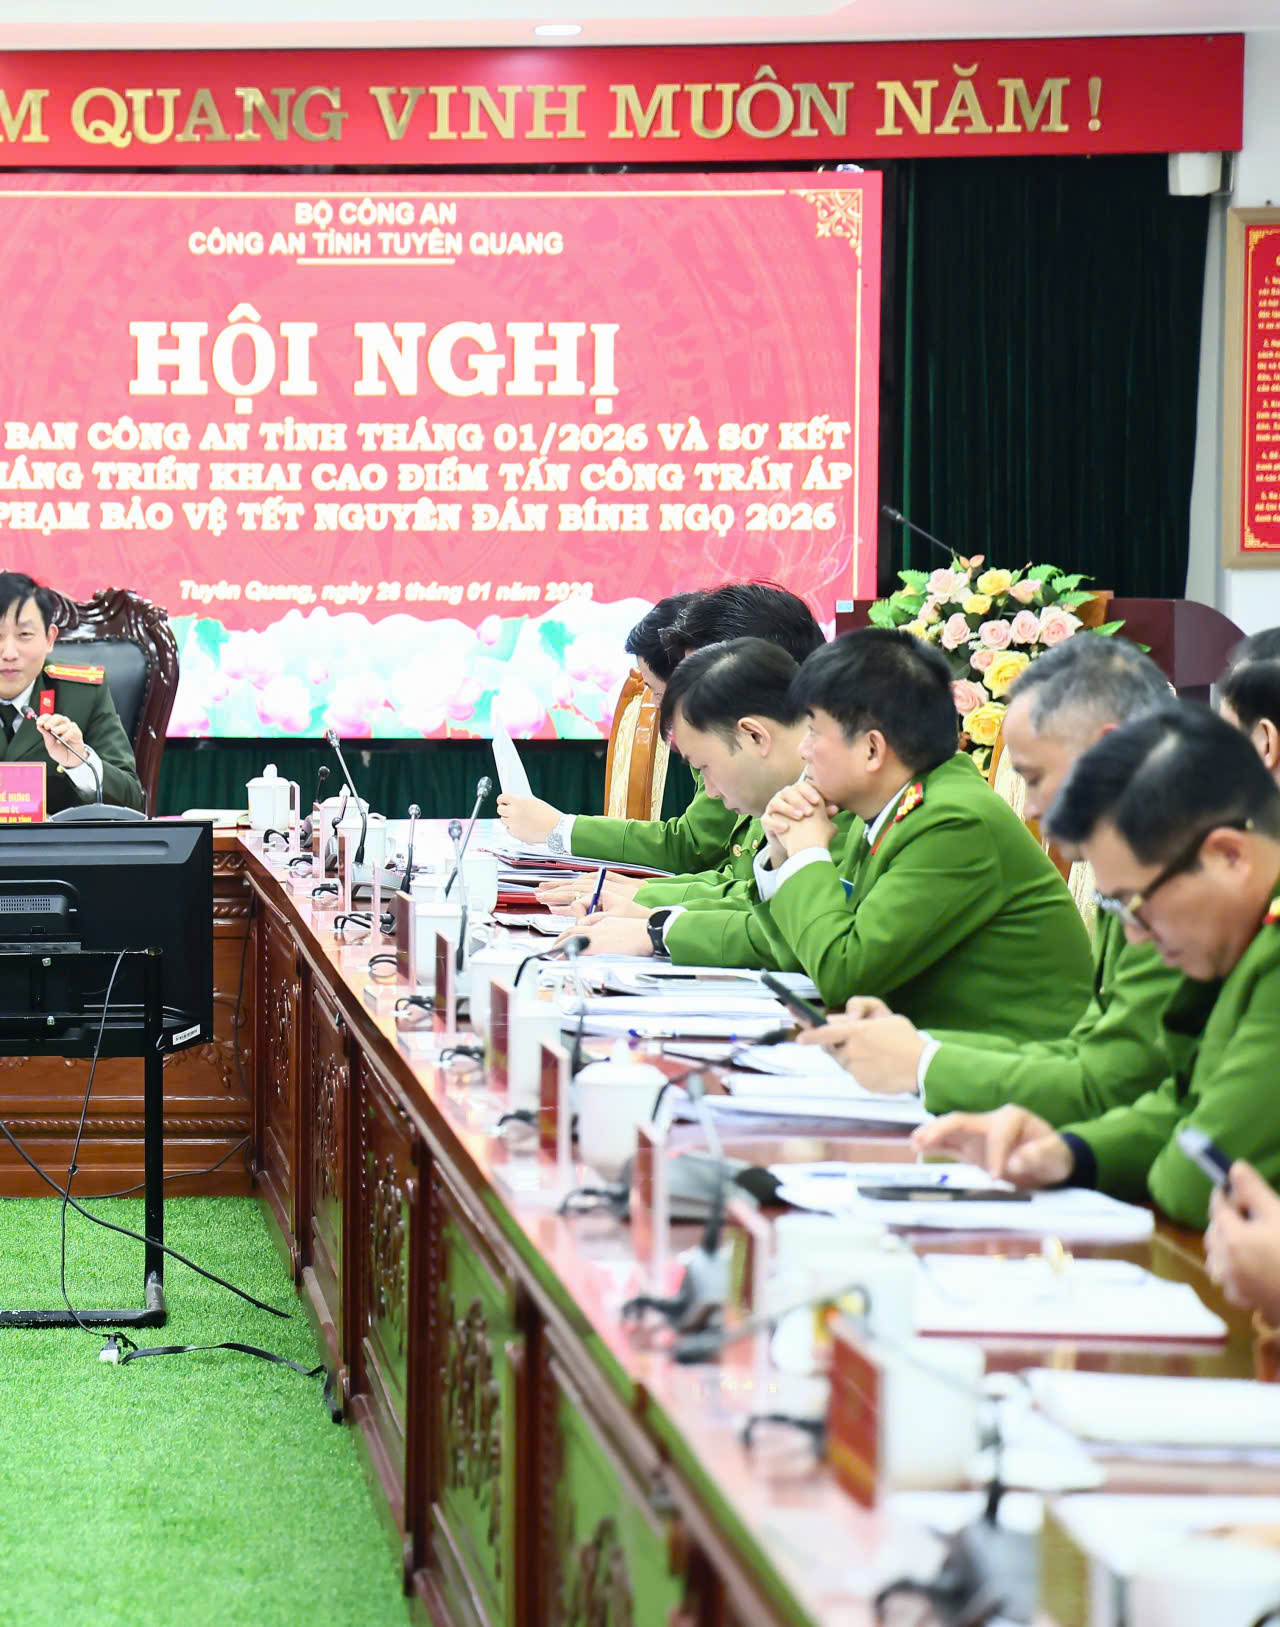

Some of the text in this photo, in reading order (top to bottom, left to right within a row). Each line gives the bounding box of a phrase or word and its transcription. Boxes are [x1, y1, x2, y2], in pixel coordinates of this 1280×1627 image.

[71, 86, 349, 148] QUANG
[369, 84, 587, 141] VINH
[608, 65, 854, 139] MUÔN
[295, 197, 456, 229] BỘ CÔNG AN
[189, 226, 563, 256] CÔNG AN TỈNH TUYÊN QUANG
[130, 303, 619, 414] HỘI NGHỊ
[5, 422, 78, 450] BAN
[88, 416, 191, 450] CÔNG
[199, 423, 250, 450] AN
[259, 416, 347, 451] TỈNH
[357, 416, 484, 451] THÁNG
[494, 423, 648, 456] 01/2026
[657, 416, 708, 450] VÀ
[718, 423, 768, 450] SƠ
[779, 416, 852, 450] KẾT
[92, 456, 200, 490] TRIỂN
[209, 463, 302, 490] KHAI
[312, 464, 387, 491] CAO
[398, 456, 488, 491] ĐIỂM
[499, 456, 570, 491] TẤN
[581, 457, 685, 491] CÔNG
[694, 456, 793, 491] TRẤN
[802, 456, 853, 490] ÁP
[100, 496, 173, 530] BẢO
[182, 497, 227, 536] VỆ
[237, 496, 304, 530] TẾT
[314, 497, 462, 530] NGUYÊN
[472, 496, 548, 531] ĐÁN
[558, 497, 648, 531] BÍNH
[660, 504, 734, 537] NGỌ
[746, 503, 836, 530] 2026
[321, 581, 373, 604] ngày
[405, 582, 464, 604] tháng
[467, 582, 491, 600] 01
[496, 582, 540, 601] năm
